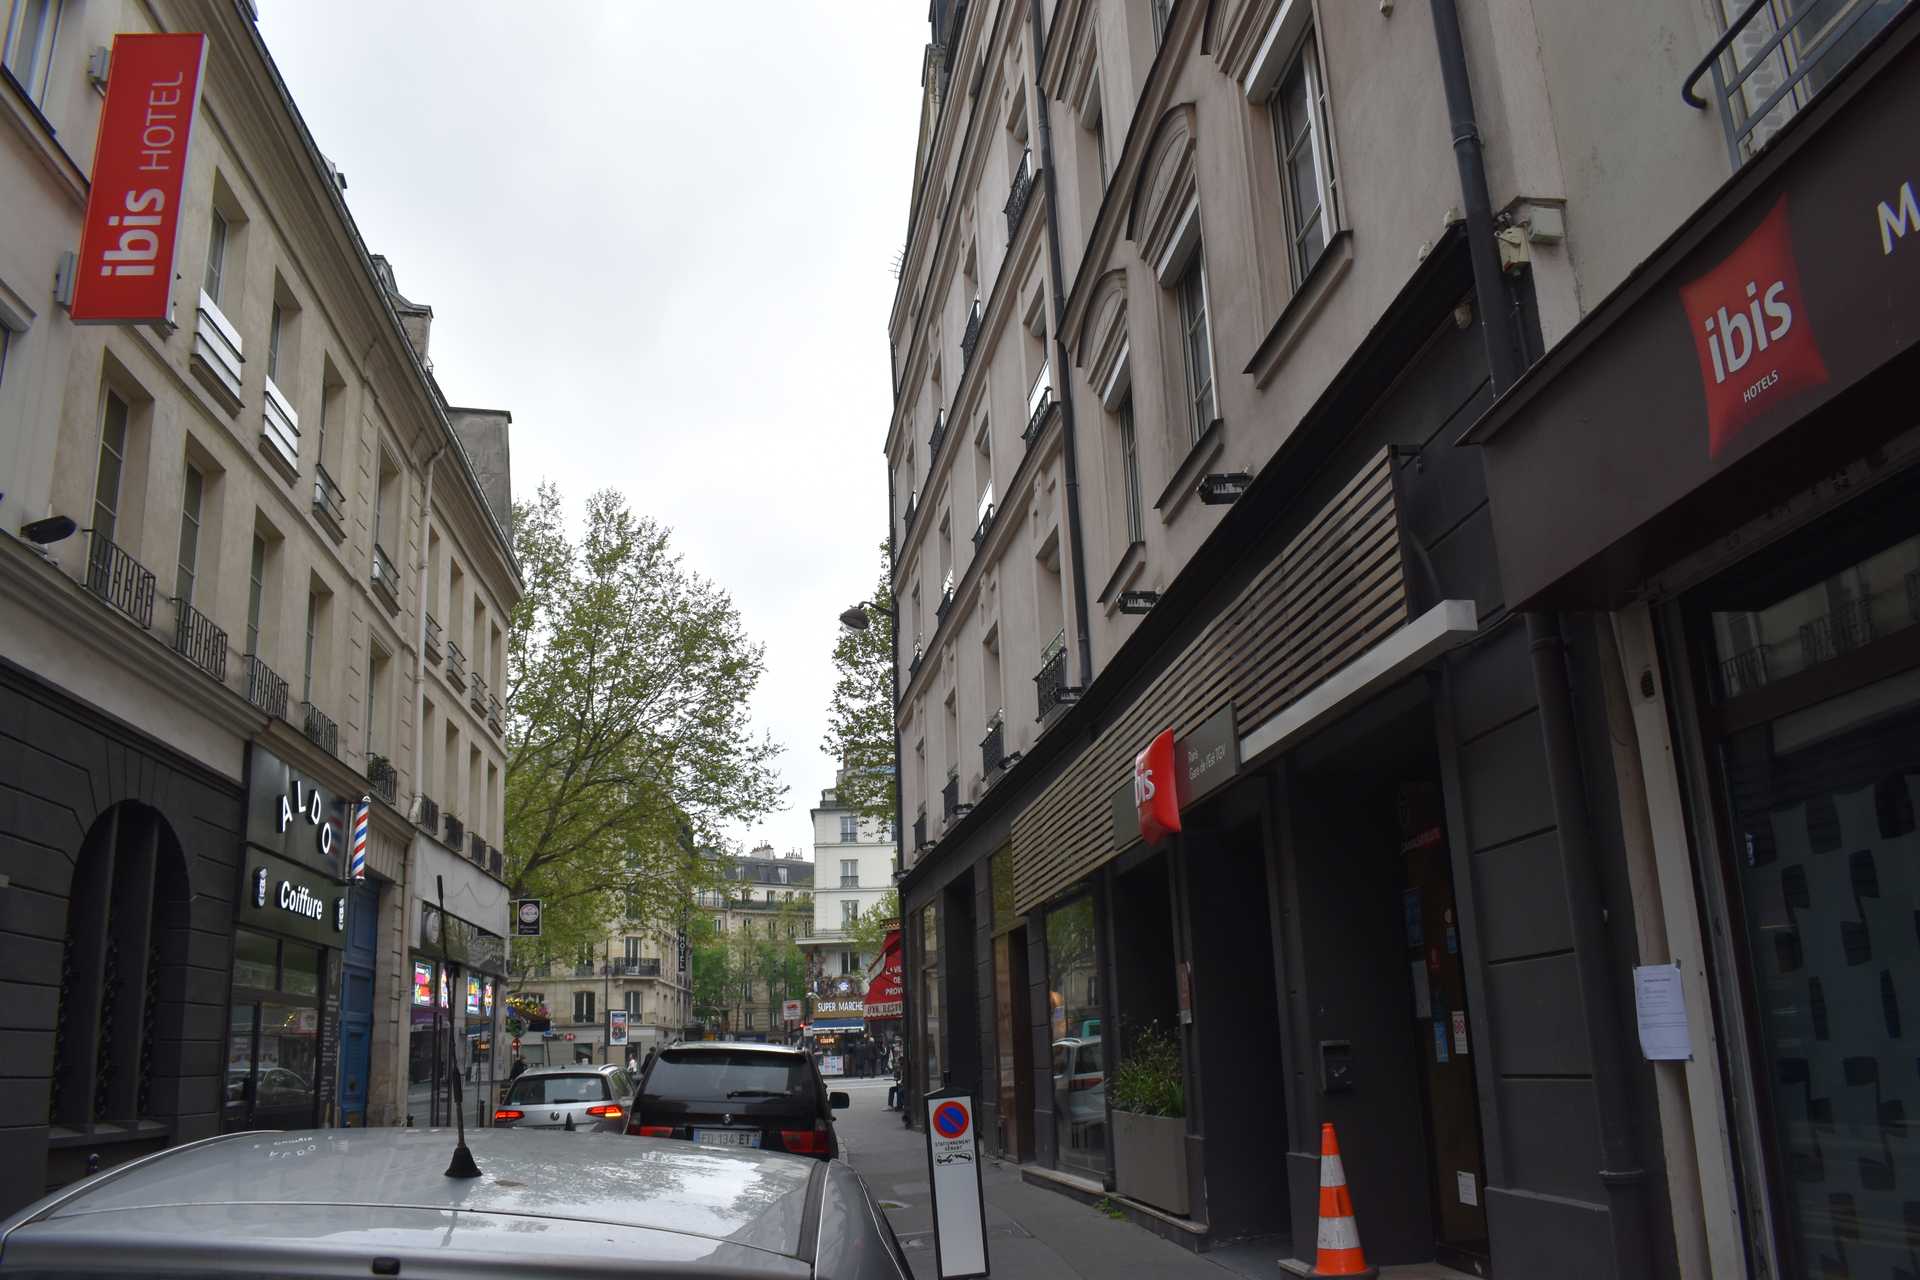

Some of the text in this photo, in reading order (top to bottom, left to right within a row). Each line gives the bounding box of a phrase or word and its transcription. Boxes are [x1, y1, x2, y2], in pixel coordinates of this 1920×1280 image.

[101, 71, 183, 277] ibis HOTEL
[1704, 280, 1793, 385] ibis
[1743, 369, 1779, 403] HOTELS
[282, 780, 332, 855] ALDO
[280, 880, 323, 921] Coiffure
[817, 1002, 836, 1012] SUPER
